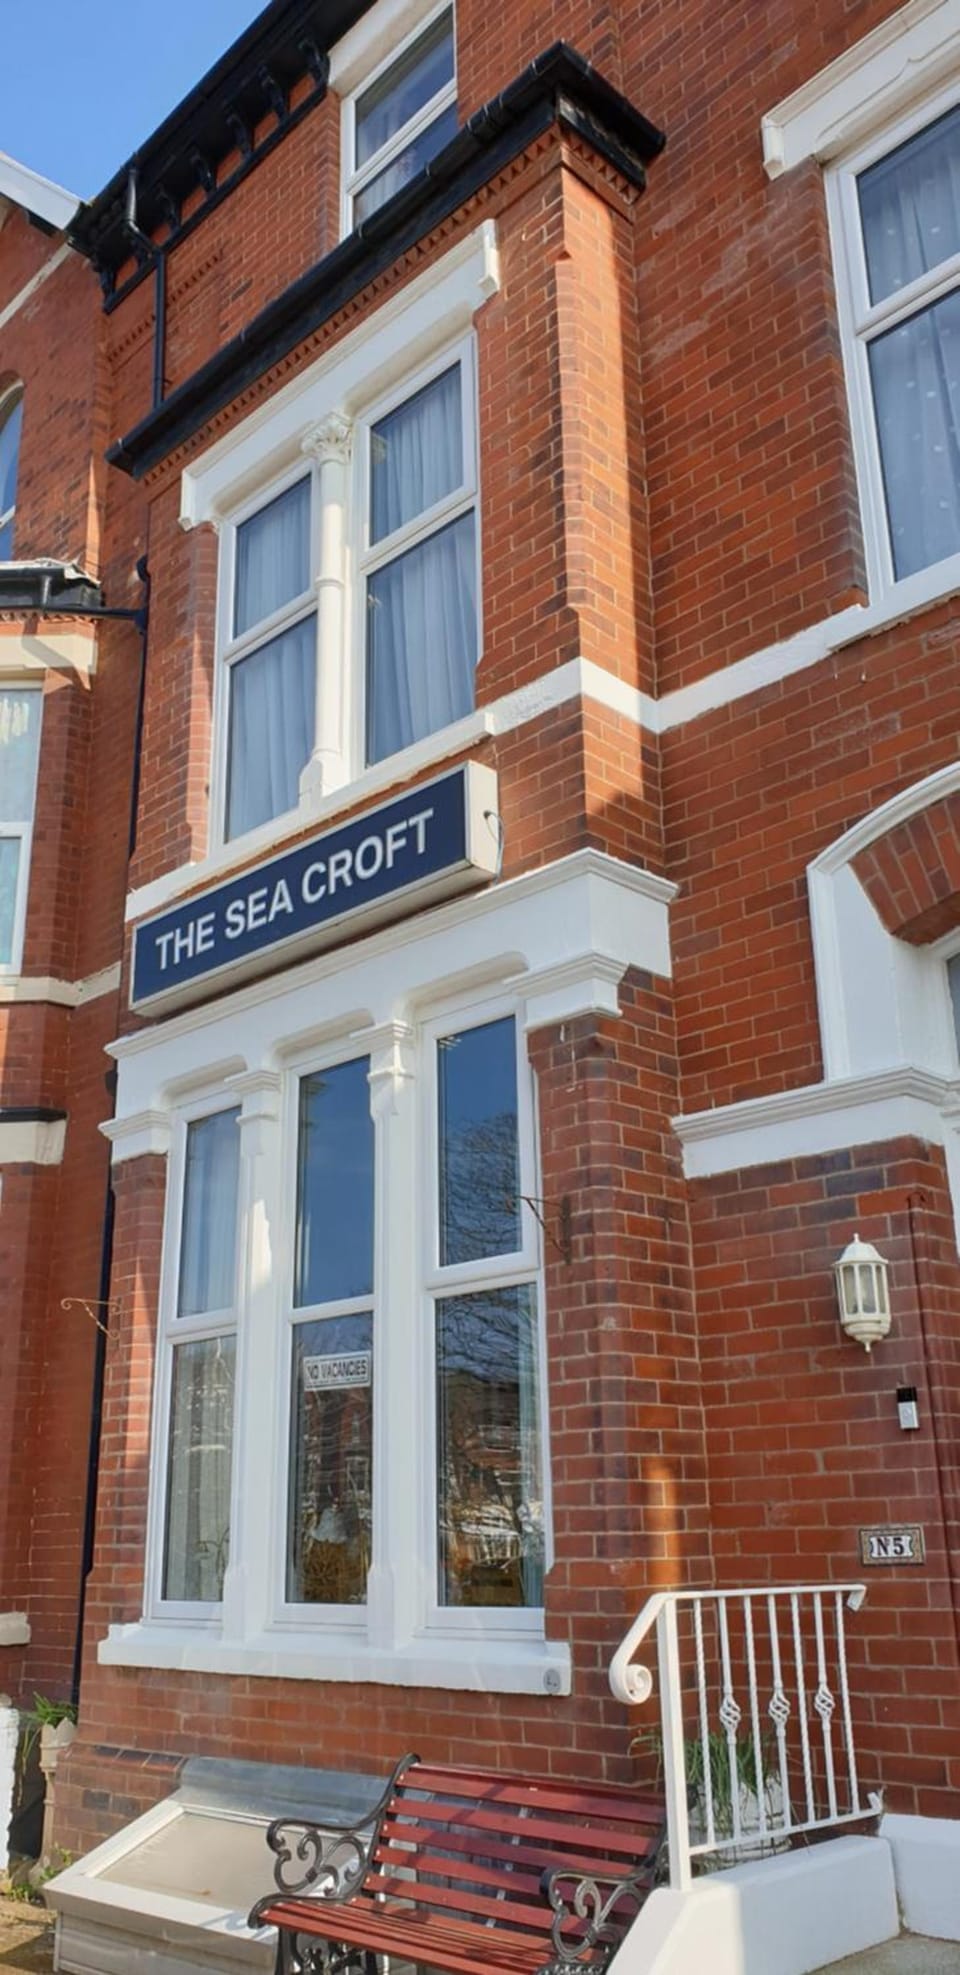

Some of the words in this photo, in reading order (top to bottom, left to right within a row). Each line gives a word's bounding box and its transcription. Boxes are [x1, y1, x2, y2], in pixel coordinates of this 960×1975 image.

[155, 913, 215, 970] THE
[224, 879, 293, 939] SEA
[302, 808, 434, 903] CROFT
[306, 1364, 319, 1380] NO
[321, 1359, 367, 1378] VACANCIES
